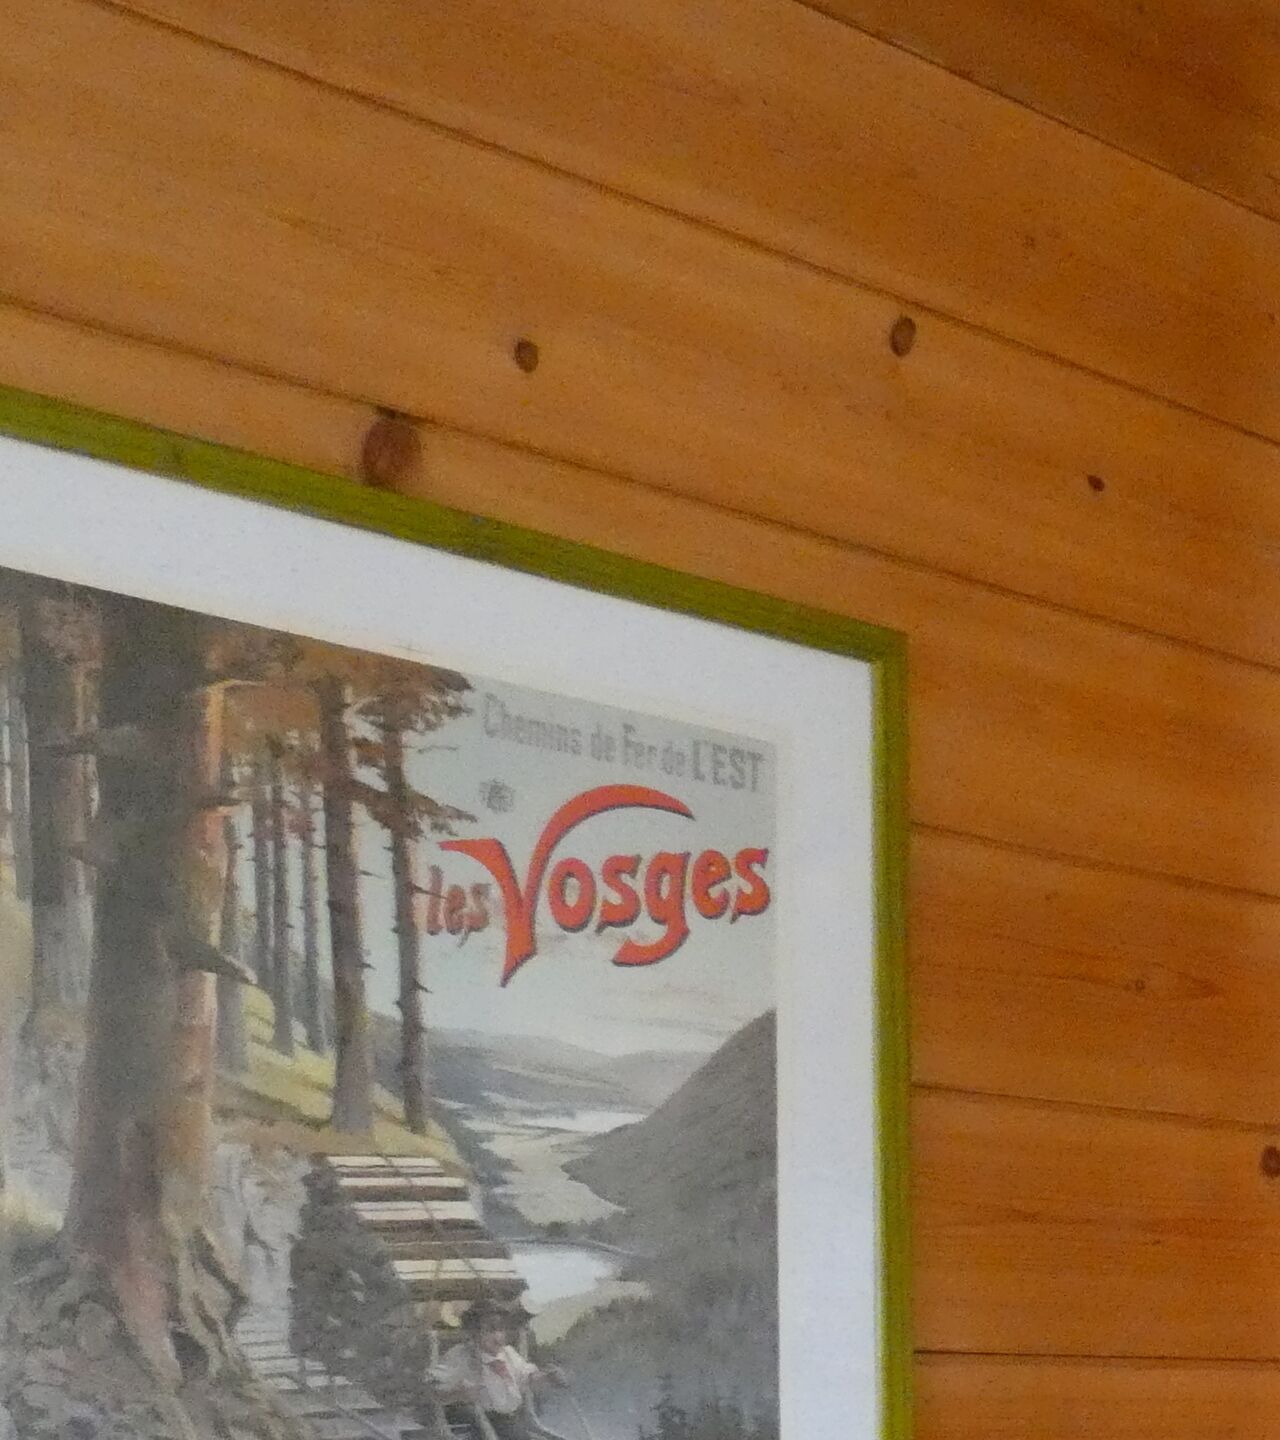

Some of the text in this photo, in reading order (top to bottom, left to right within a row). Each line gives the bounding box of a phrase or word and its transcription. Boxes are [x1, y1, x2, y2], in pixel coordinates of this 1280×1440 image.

[590, 722, 615, 763] de
[622, 723, 658, 770] Fer
[426, 783, 771, 988] les Vosges
